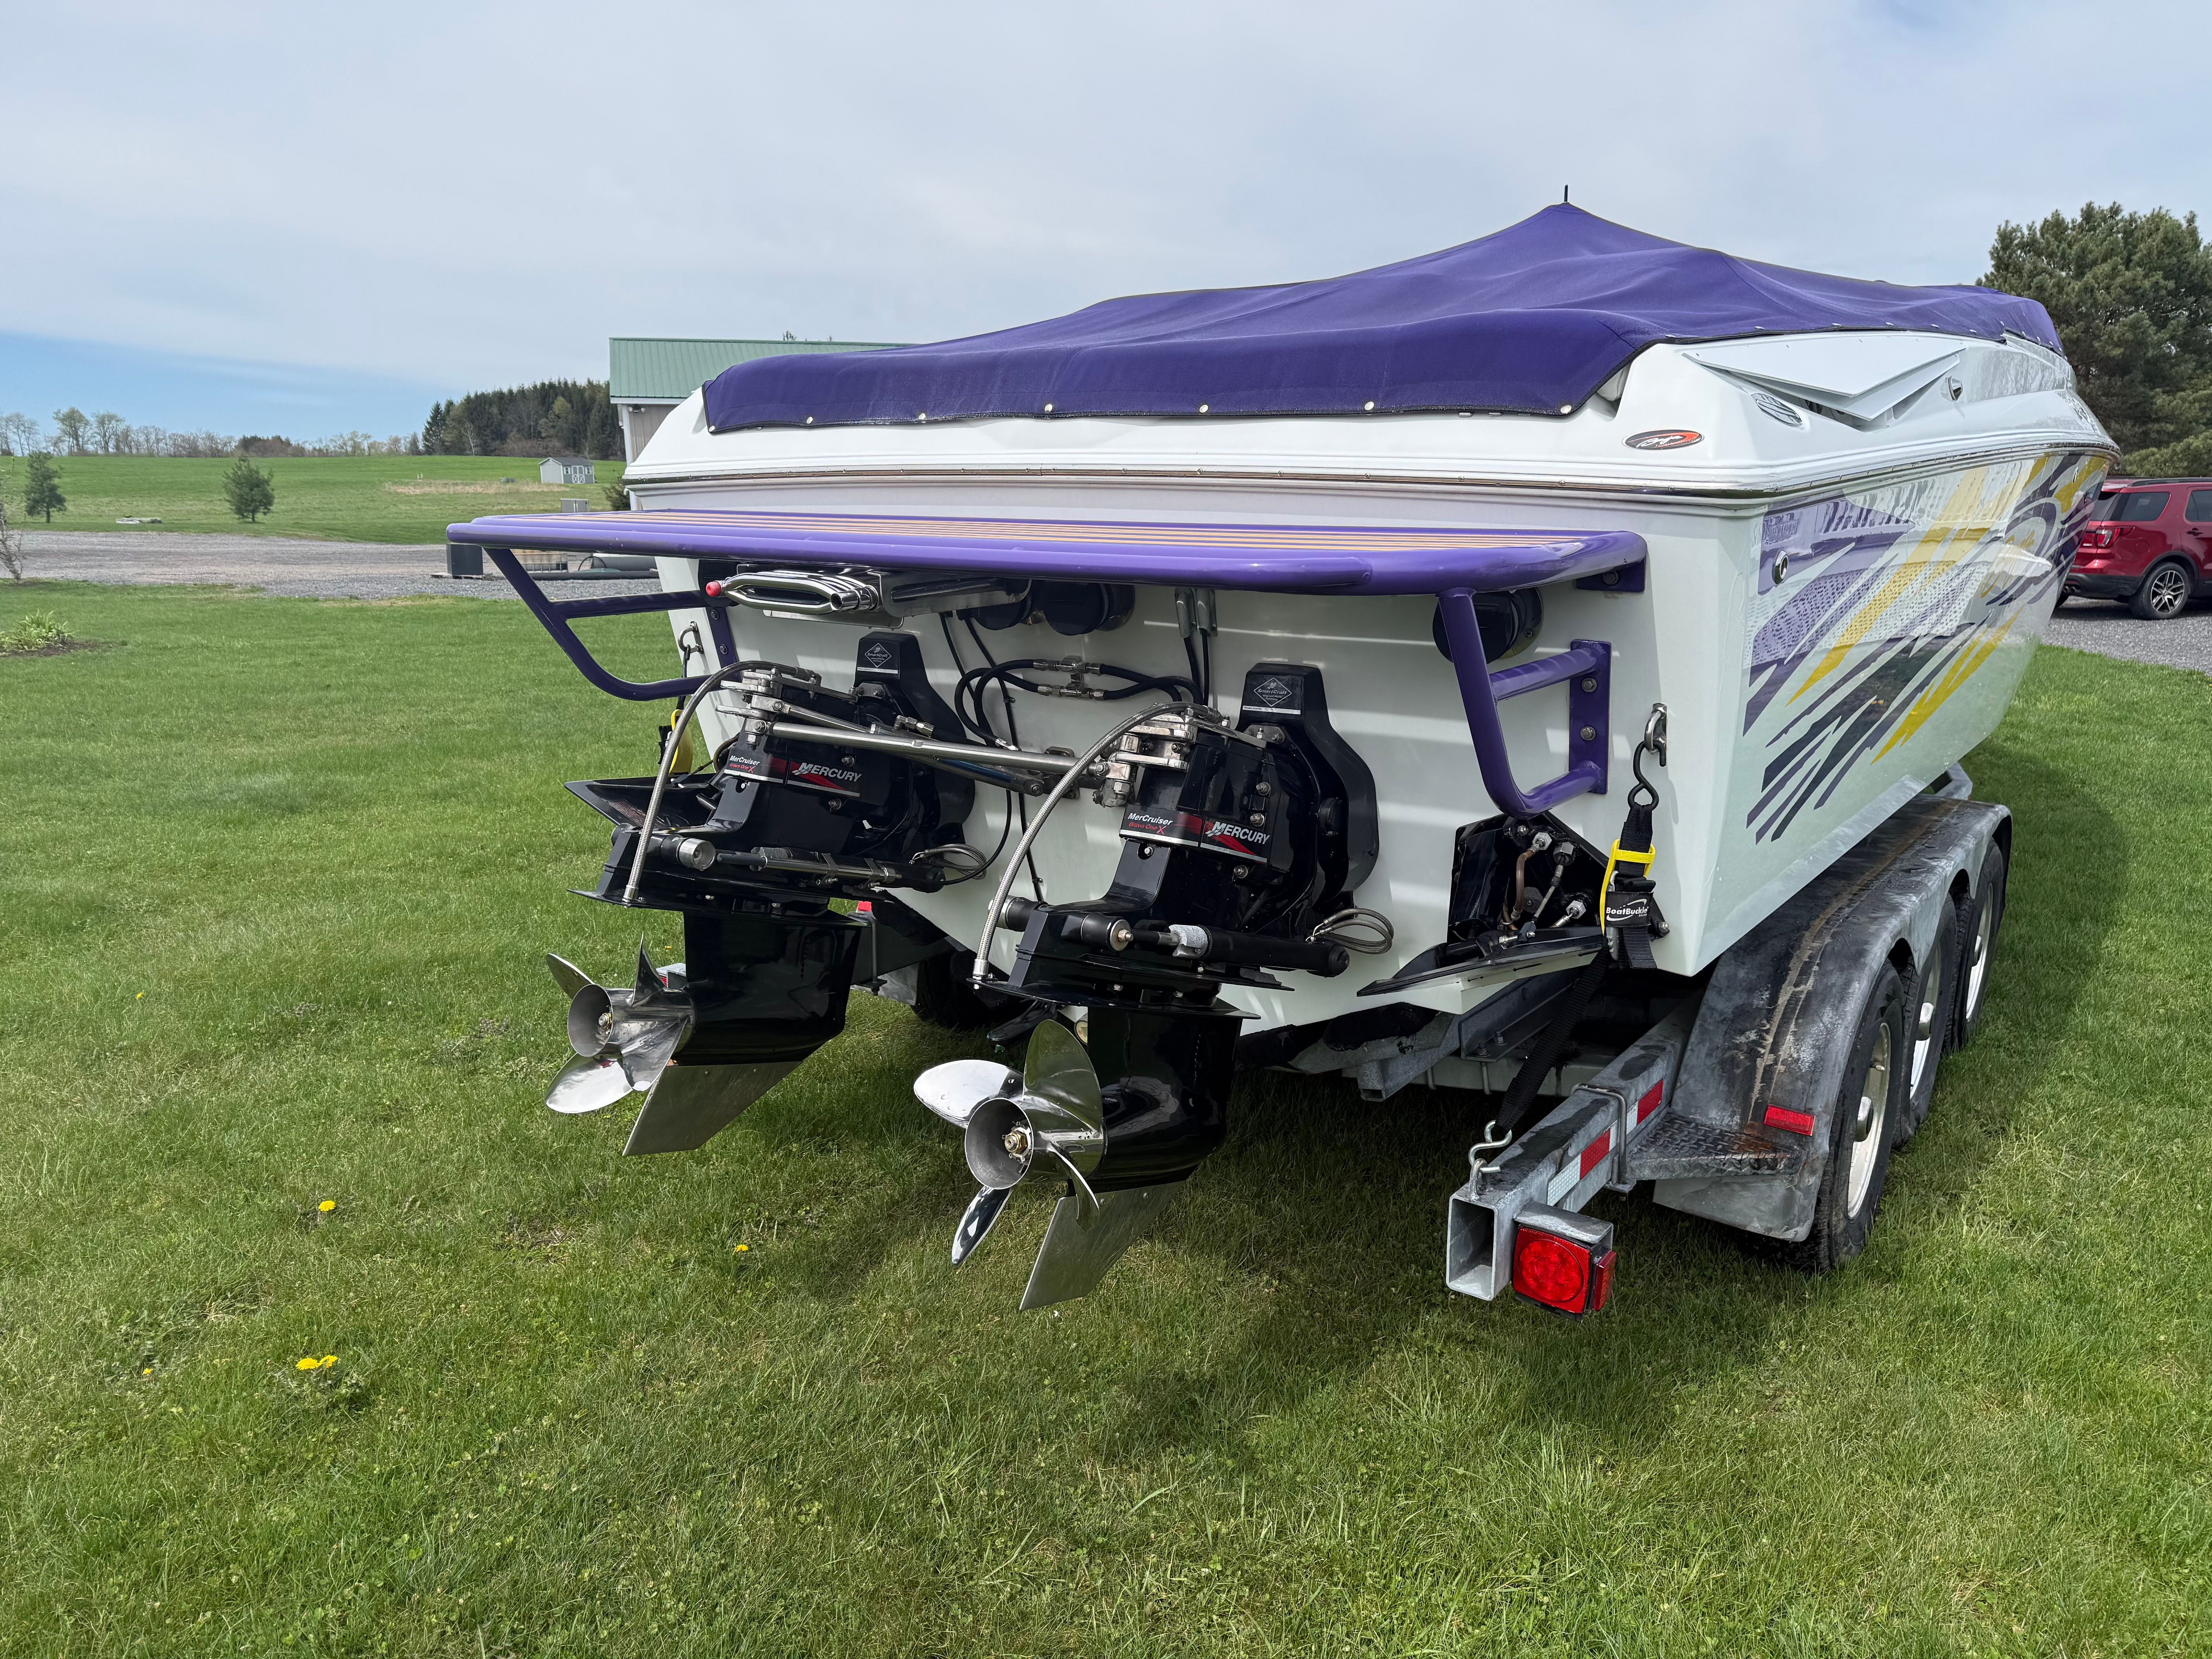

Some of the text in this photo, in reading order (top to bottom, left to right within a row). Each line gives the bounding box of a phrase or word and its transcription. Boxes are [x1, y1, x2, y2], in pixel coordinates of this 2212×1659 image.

[729, 755, 760, 766] MerCruiser
[792, 763, 862, 782] MERCURY
[1128, 812, 1173, 825] MerCruiser
[1205, 821, 1270, 845] MERCURY
[1606, 907, 1648, 915] BoatBuckle
